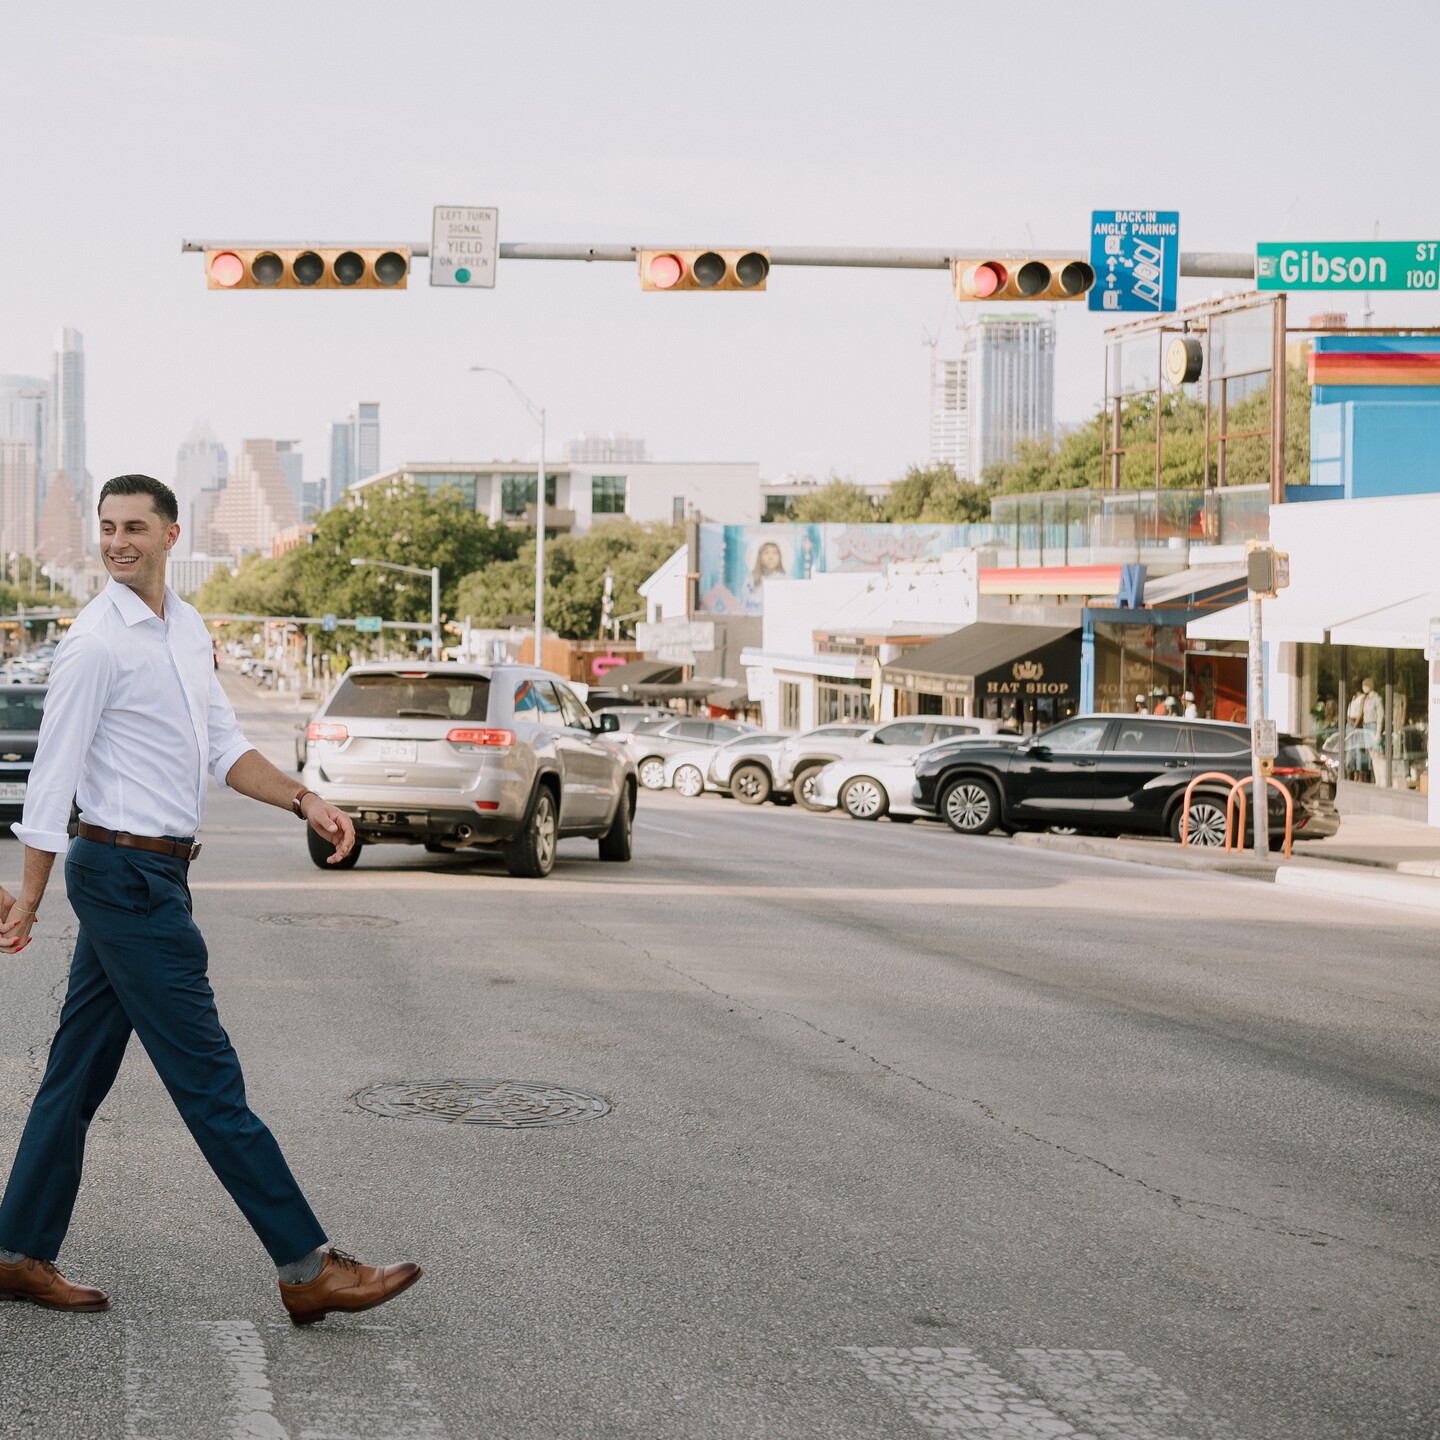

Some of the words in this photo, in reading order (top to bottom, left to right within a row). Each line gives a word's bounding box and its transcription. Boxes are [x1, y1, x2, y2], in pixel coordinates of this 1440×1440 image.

[440, 210, 462, 220] LEFT
[468, 211, 491, 221] TURN
[1115, 211, 1157, 223] BACK-IN
[448, 224, 481, 234] SIGNAL
[1094, 223, 1127, 235] ANGLE
[1132, 223, 1177, 236] PARKING
[447, 241, 483, 253] YIELD
[1416, 243, 1438, 261] ST
[440, 257, 453, 266] ON
[458, 257, 488, 267] GREEN
[1258, 257, 1271, 275] E
[1279, 250, 1387, 283] Gibson
[1407, 270, 1437, 288] 100
[987, 682, 1020, 693] HAT
[1026, 682, 1069, 694] SHOP
